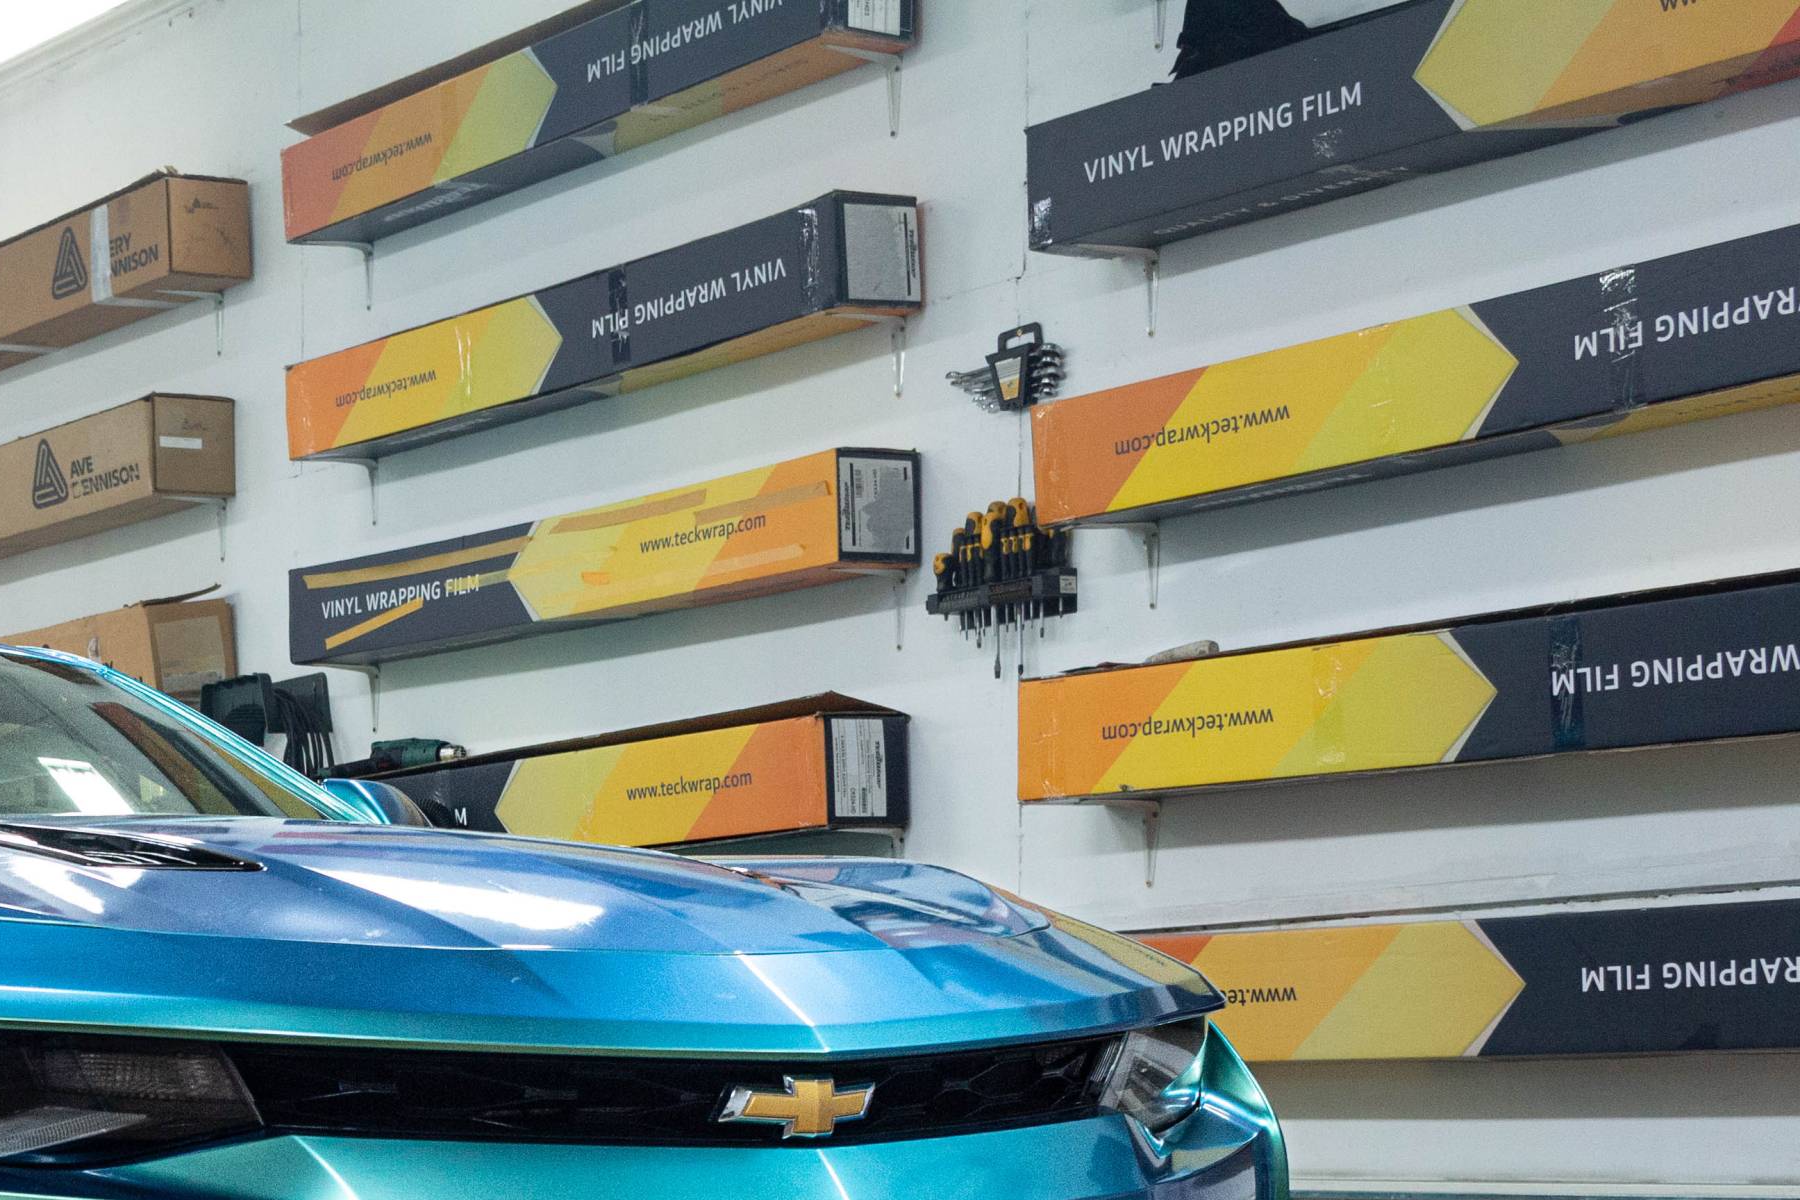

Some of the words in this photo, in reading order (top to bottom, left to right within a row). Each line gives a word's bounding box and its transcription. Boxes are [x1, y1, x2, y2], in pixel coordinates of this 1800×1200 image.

[631, 15, 723, 64] WRAPPING
[587, 53, 625, 83] FILM
[1084, 144, 1154, 183] VINYL
[1160, 102, 1293, 162] WRAPPING
[1302, 81, 1362, 122] FILM
[332, 132, 433, 181] www.teckwrap.com
[110, 232, 132, 258] ERY
[111, 244, 159, 277] NNISON
[731, 258, 786, 292] VINYL
[635, 276, 726, 325] WRAPPING
[1655, 286, 1800, 343] RAPPING
[1574, 320, 1643, 361] FILM
[336, 369, 437, 408] www.teckwrap.com
[1114, 404, 1290, 456] www.teckwrap.com
[639, 514, 766, 554] www.teckwrap.com
[321, 596, 362, 620] VINYL
[365, 581, 441, 611] WRAPPING
[445, 574, 480, 598] FILM
[1552, 664, 1619, 697] FILM
[1631, 644, 1800, 688] WRAPPING
[1102, 708, 1275, 740] www.teckwrap.com
[626, 772, 752, 802] www.teckwrap.com
[1581, 963, 1650, 993] FILM
[1662, 956, 1800, 989] RAPPING
